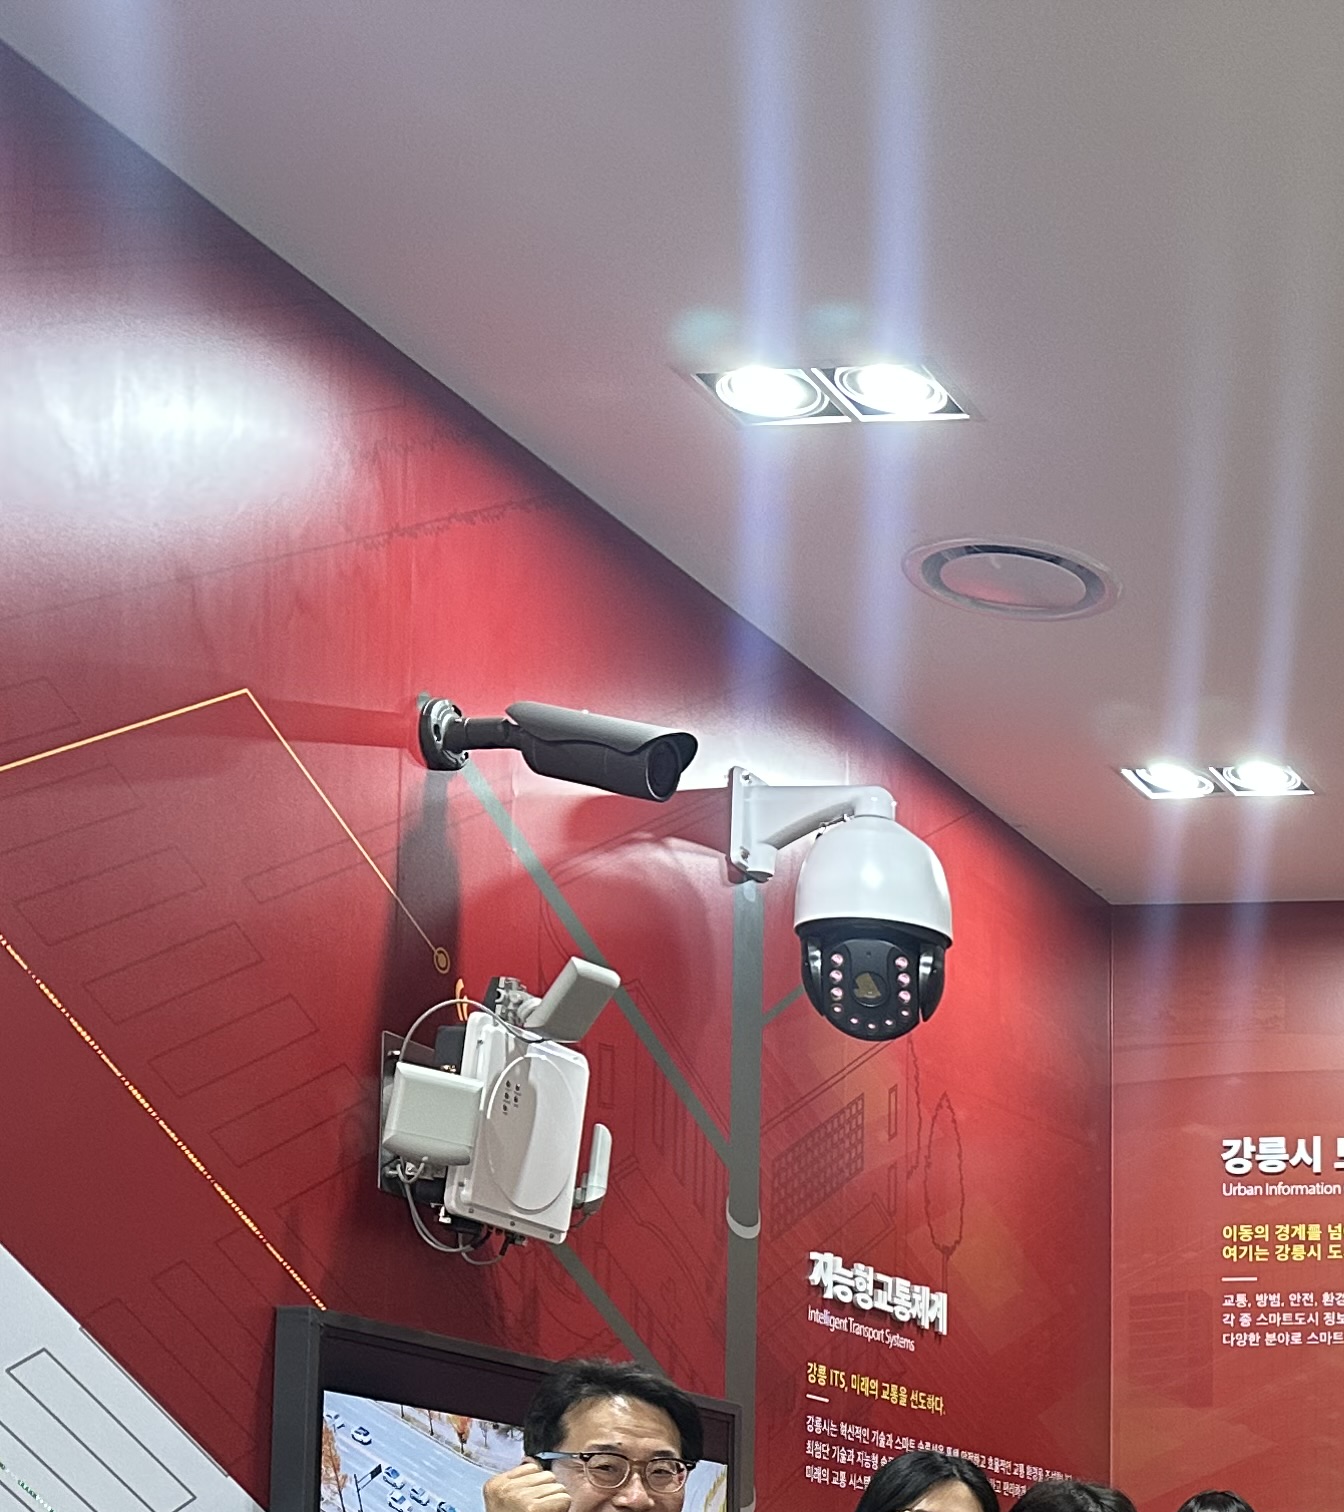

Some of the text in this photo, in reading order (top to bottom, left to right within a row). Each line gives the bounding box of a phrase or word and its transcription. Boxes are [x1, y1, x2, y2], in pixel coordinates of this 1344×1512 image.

[1220, 1136, 1322, 1175] 강릉시
[1222, 1182, 1262, 1196] Urban
[1265, 1181, 1342, 1195] Information
[1222, 1224, 1269, 1242] 이동의
[1274, 1223, 1322, 1241] 경계를
[1222, 1245, 1270, 1262] 여기는
[1274, 1244, 1322, 1261] 강릉시
[808, 1251, 948, 1335] 지능형교통체계
[1222, 1293, 1252, 1308] 교통,
[1256, 1293, 1285, 1308] 방범,
[1289, 1292, 1318, 1307] 안전,
[808, 1304, 915, 1351] Intelligent Transport Systems
[1222, 1313, 1236, 1328] 각
[1256, 1312, 1319, 1326] 스마트도시
[1222, 1332, 1260, 1347] 다양한
[1264, 1332, 1303, 1346] 분야로
[1306, 1331, 1344, 1345] 스마트
[807, 1362, 946, 1416] 강릉 ITS, 미래의 교통을 선도하다.
[806, 1415, 839, 1438] 강릉시는
